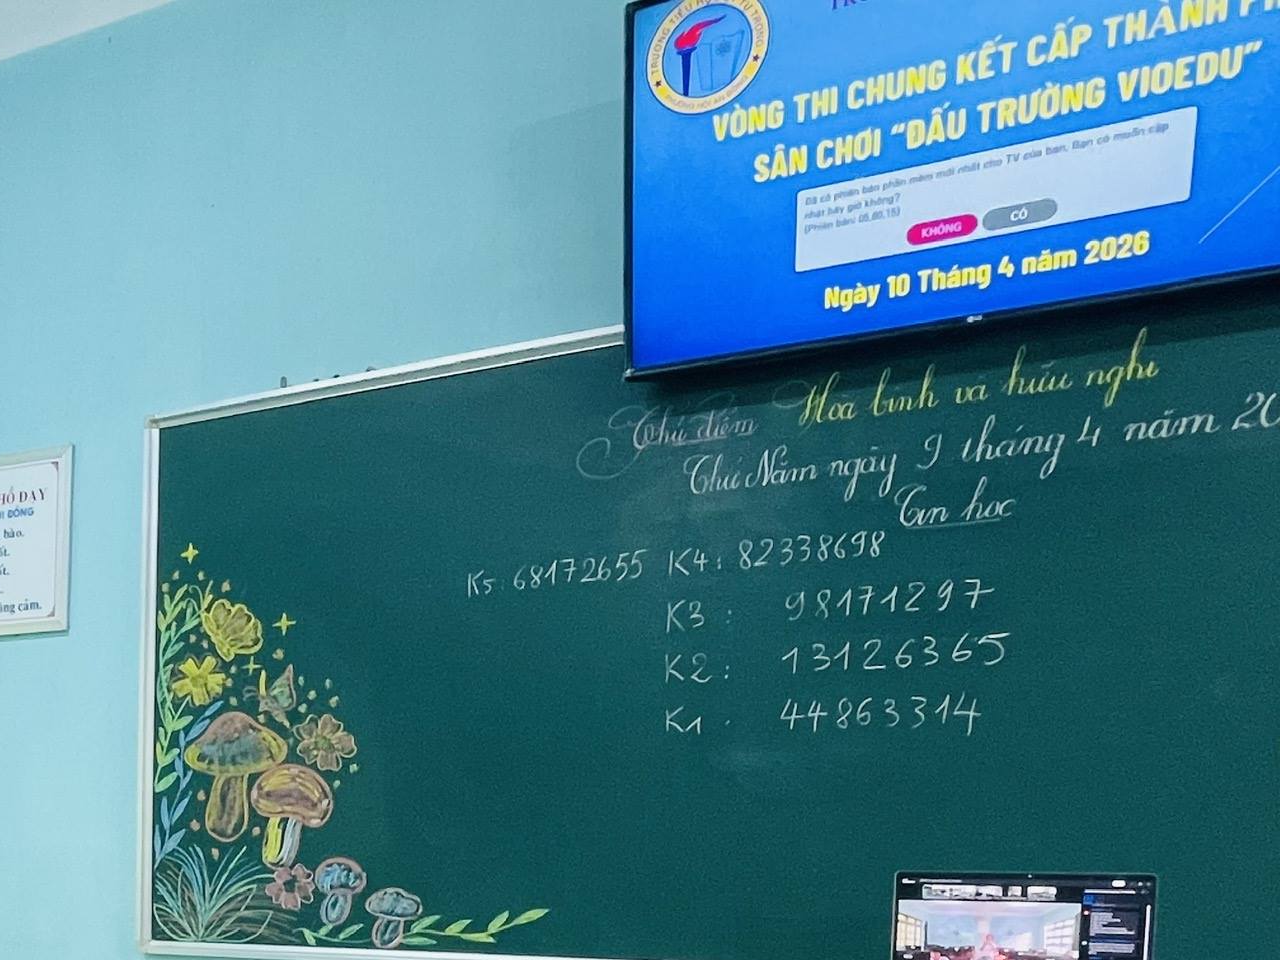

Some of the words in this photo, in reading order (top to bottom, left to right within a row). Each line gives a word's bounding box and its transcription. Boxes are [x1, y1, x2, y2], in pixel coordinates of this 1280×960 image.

[712, 101, 785, 142] VÒNG
[793, 86, 839, 124] THI
[847, 59, 946, 110] CHUNG
[955, 34, 1018, 85] KẾT
[1026, 16, 1093, 67] CẤP
[1103, 0, 1229, 48] THÀNH
[753, 144, 807, 183] SÂN
[816, 127, 881, 170] CHƠI
[976, 77, 1106, 134] TRƯỜNG
[1006, 153, 1020, 164] TV
[921, 221, 963, 239] KHÔNG
[1010, 205, 1028, 221] CÓ
[824, 283, 880, 312] Ngày
[887, 273, 911, 298] 10
[917, 260, 992, 291] Tháng
[998, 255, 1015, 280] 4
[1021, 247, 1077, 275] năm
[1084, 230, 1151, 265] 2026
[960, 414, 1065, 480] tháng
[1076, 415, 1102, 447] 4
[1124, 409, 1222, 442] năm
[513, 549, 649, 590] 68172655
[738, 530, 886, 570] 82338698
[784, 579, 996, 621] 98171297
[781, 632, 1012, 675] 13126365
[780, 692, 982, 737] 44863314
